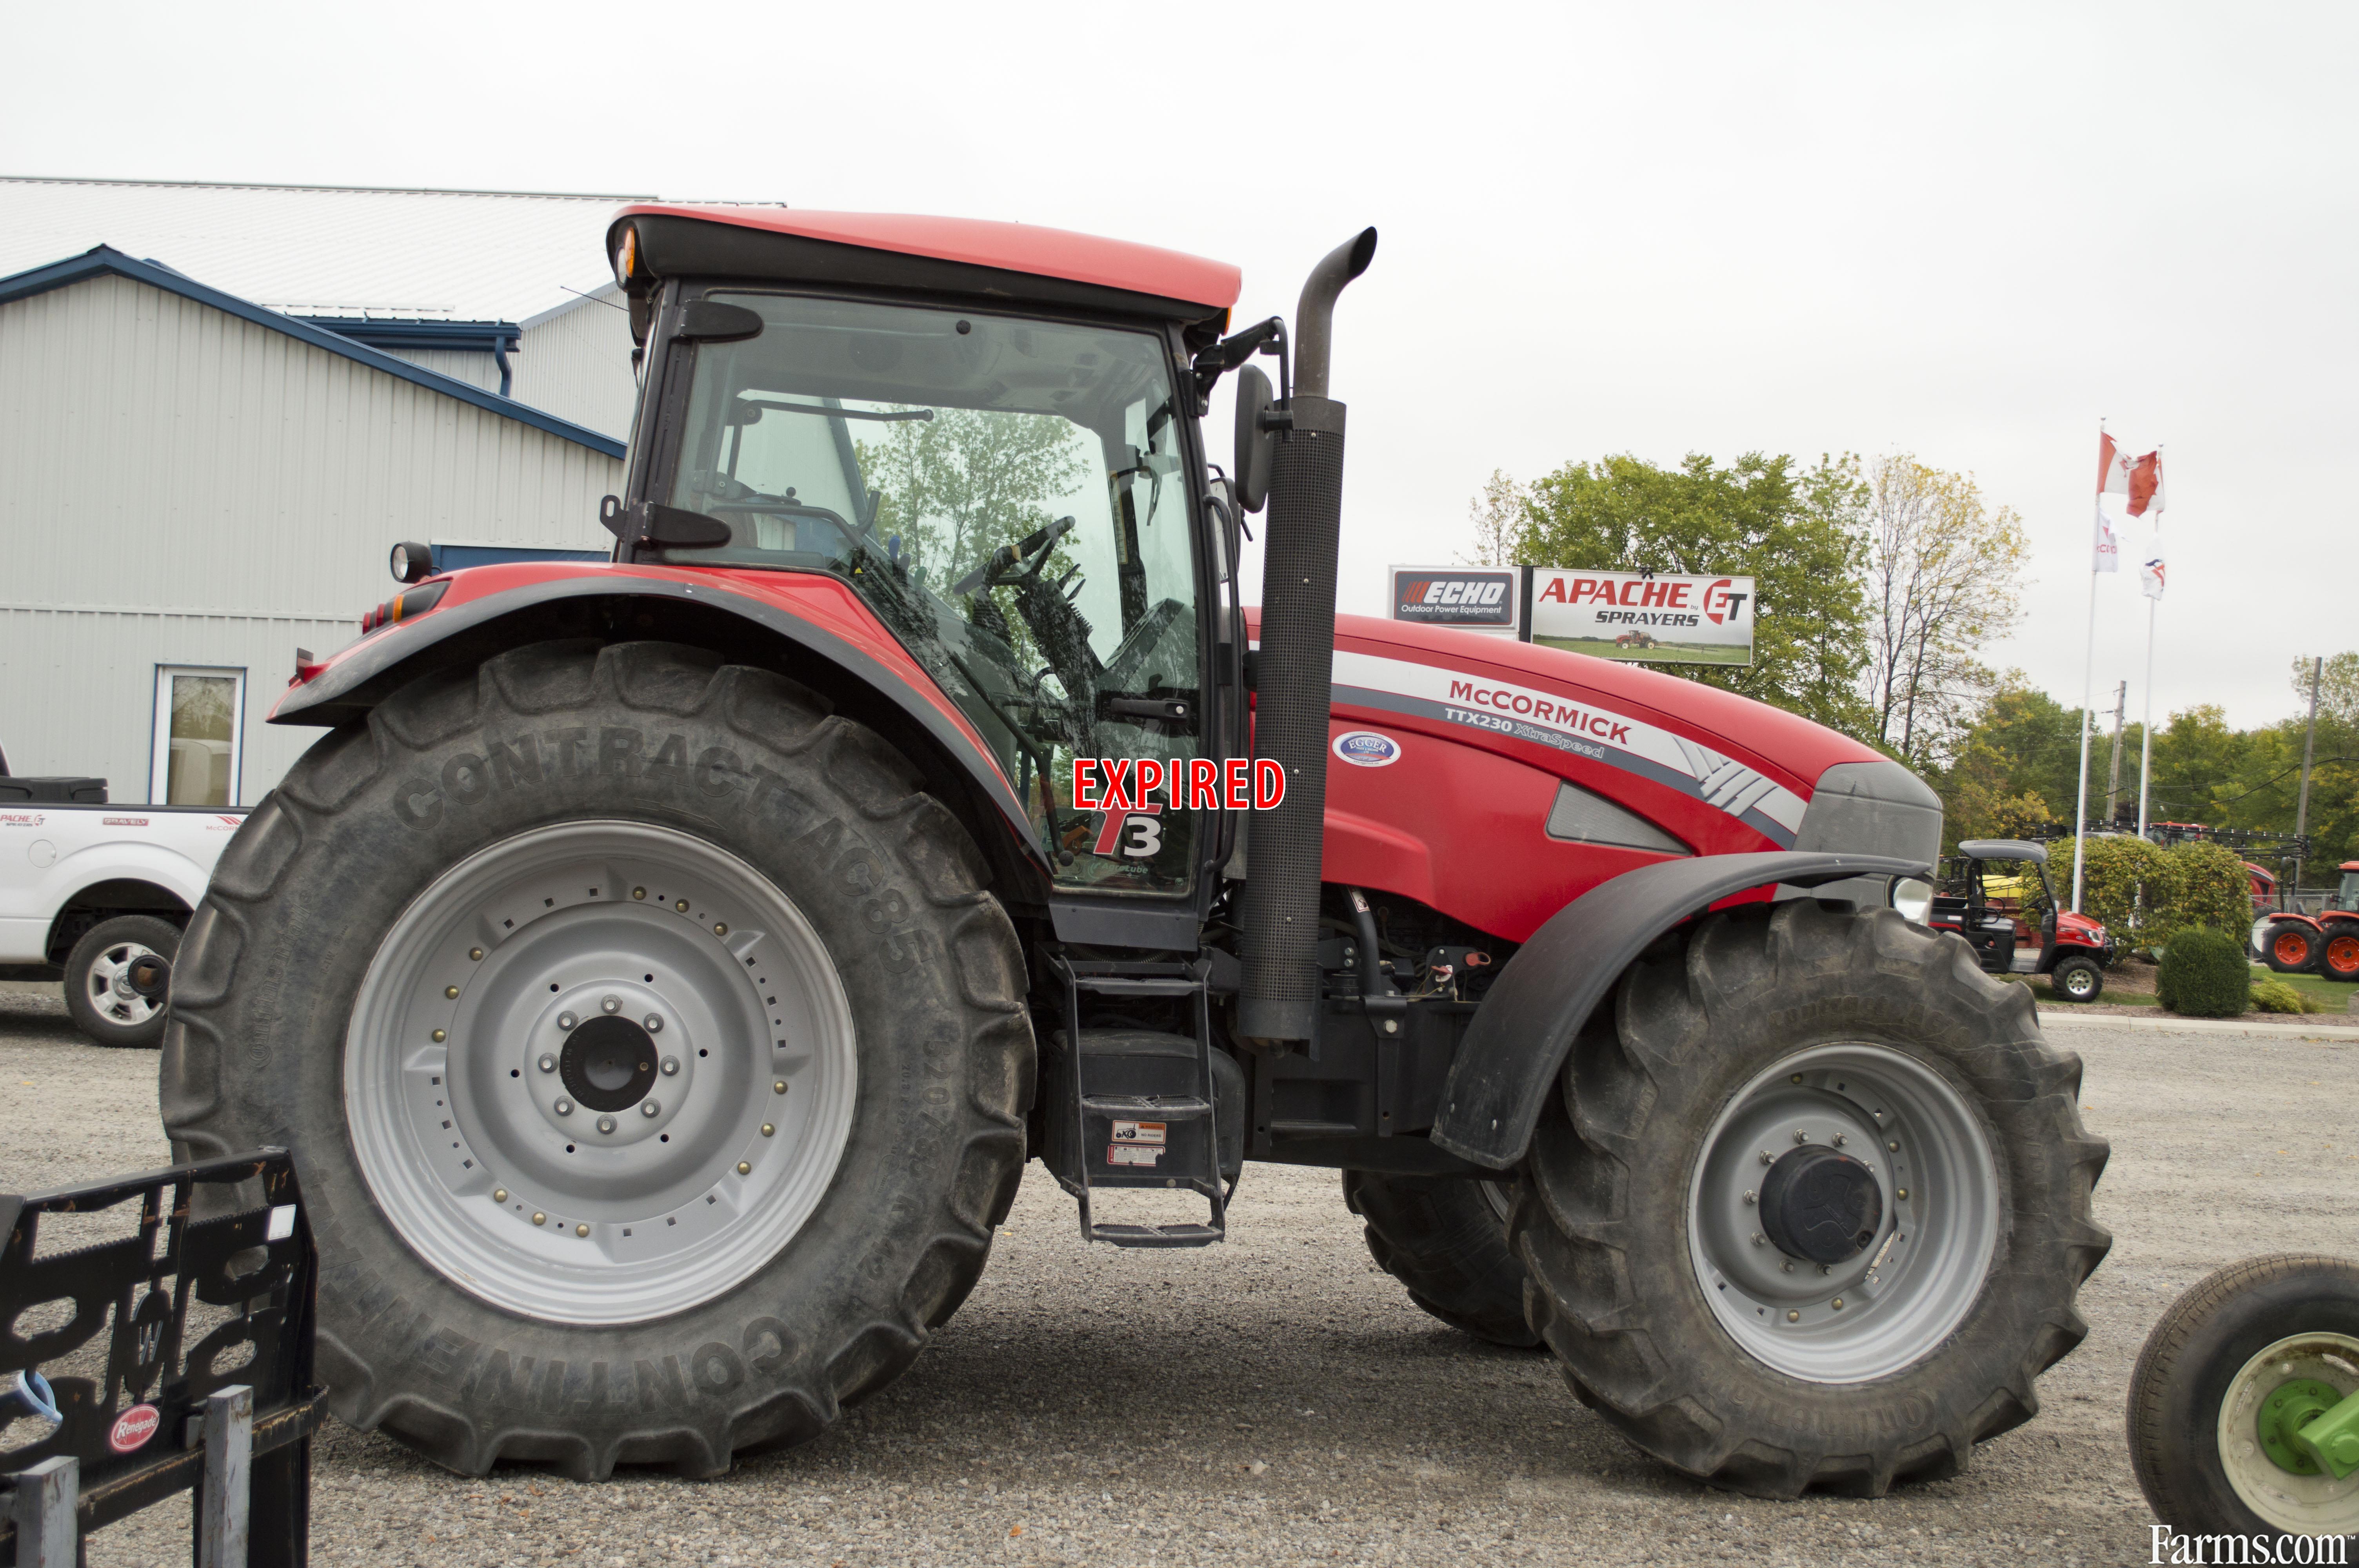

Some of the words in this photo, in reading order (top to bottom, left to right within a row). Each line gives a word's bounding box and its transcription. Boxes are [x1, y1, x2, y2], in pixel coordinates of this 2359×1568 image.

[1424, 582, 1505, 604] ECHO
[1539, 578, 1692, 609] APACHE
[1401, 605, 1434, 614] Outdoor
[1460, 606, 1501, 615] Equipment
[1595, 611, 1699, 627] SPRAYERS
[1445, 708, 1513, 733] TTX230
[1514, 724, 1604, 759] XtraSpeed
[1348, 738, 1387, 753] EGGER
[392, 725, 791, 830] CONTRACT
[1090, 802, 1164, 857] T3
[116, 1416, 156, 1439] Renegade
